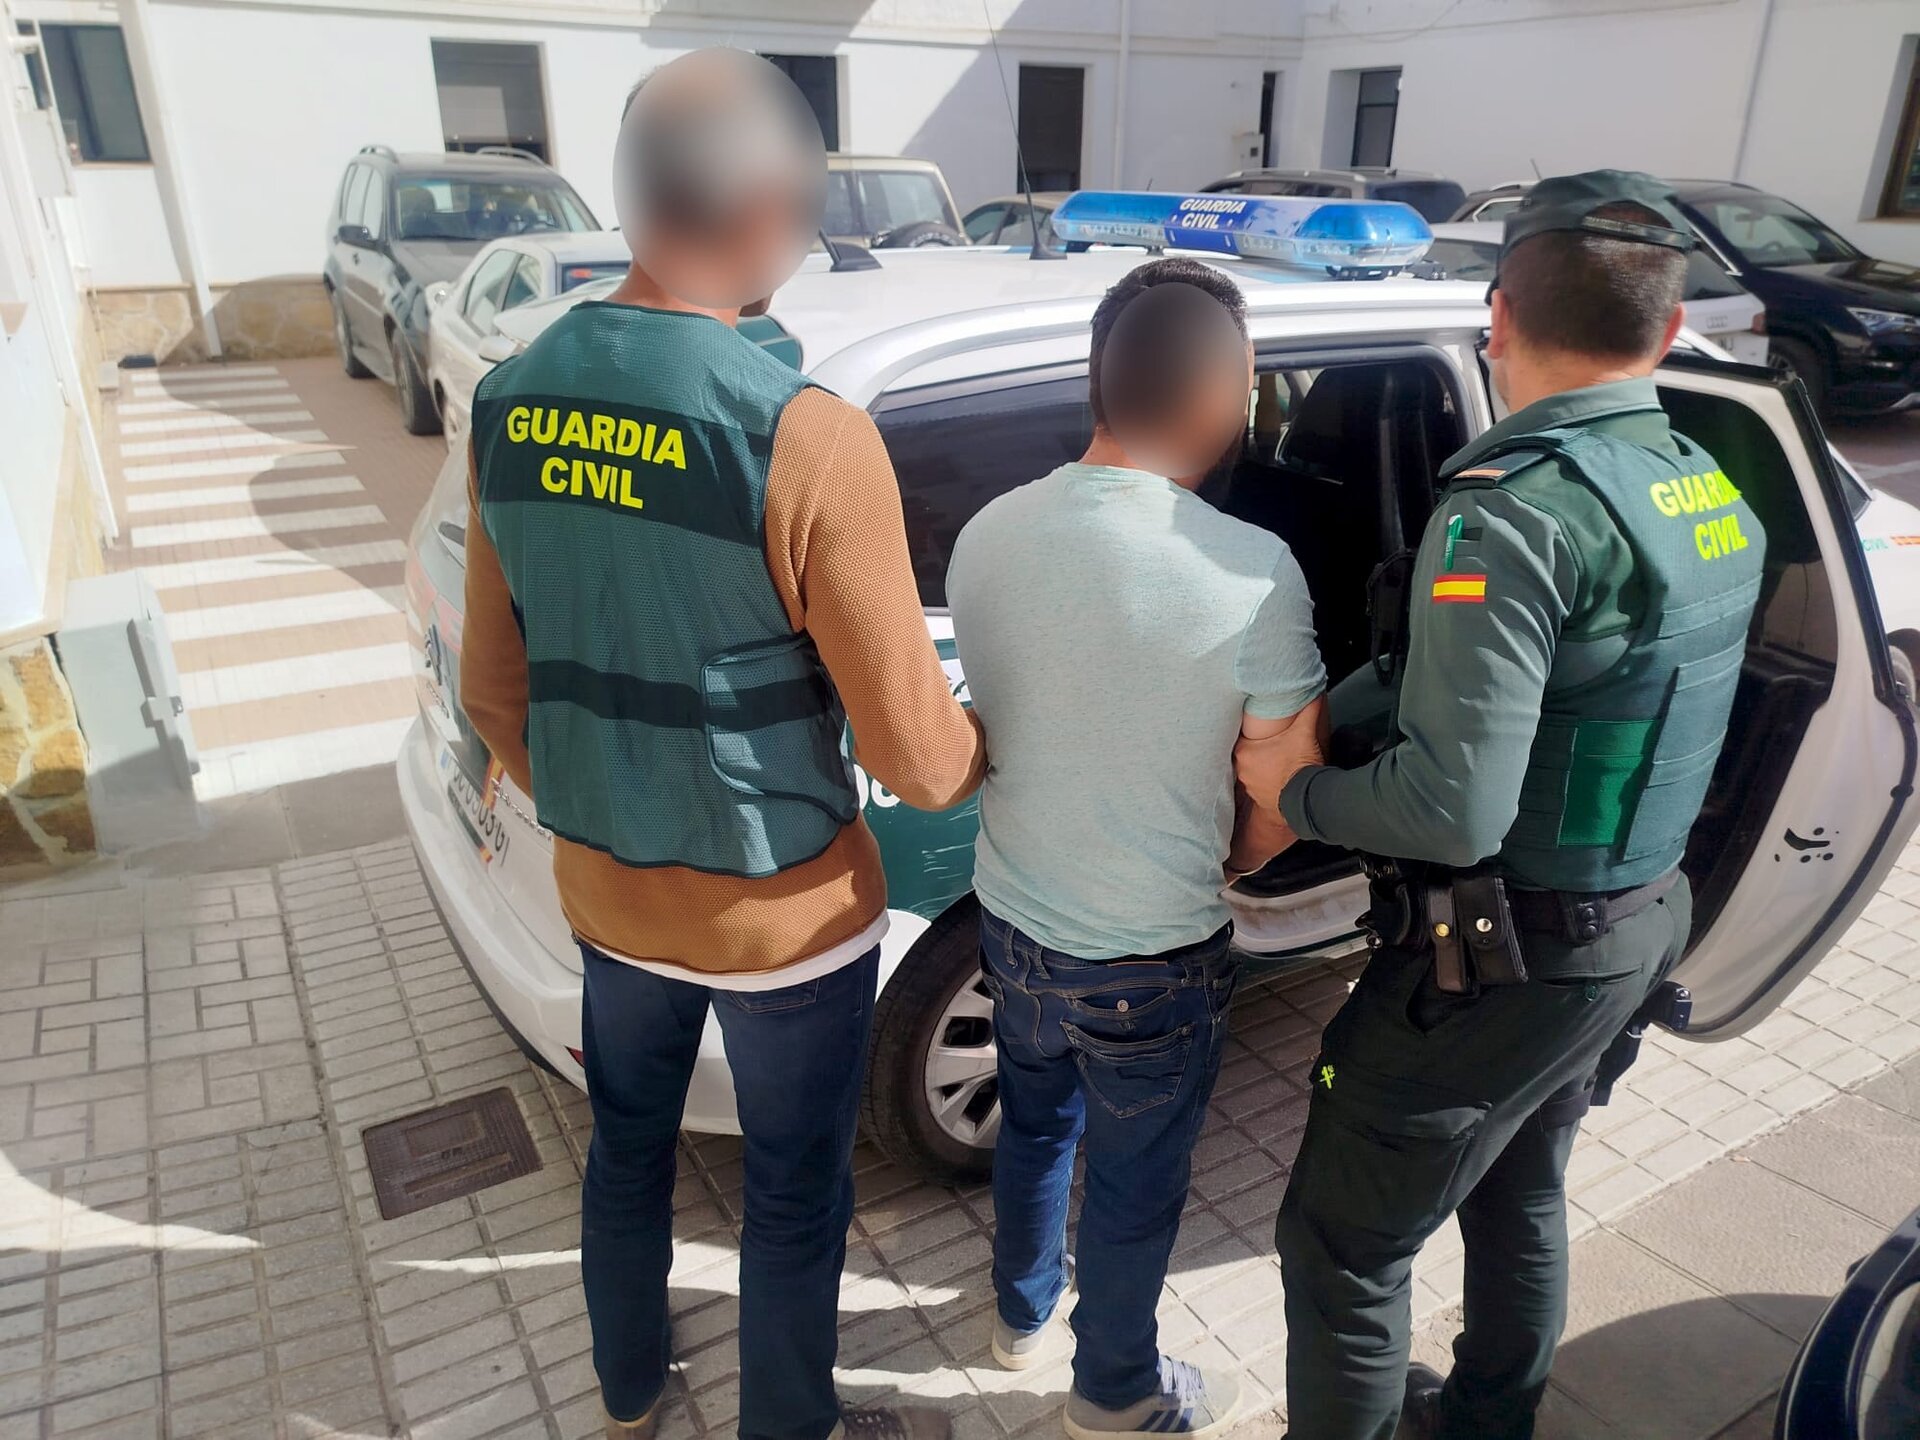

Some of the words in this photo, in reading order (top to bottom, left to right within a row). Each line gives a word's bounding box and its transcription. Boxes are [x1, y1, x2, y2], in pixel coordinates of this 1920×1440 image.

[1179, 198, 1247, 214] GUARDIA
[1181, 213, 1220, 230] CIVIL
[507, 406, 686, 470] GUARDIA
[541, 457, 643, 510] CIVIL
[1650, 469, 1742, 517] GUARD
[1695, 514, 1748, 560] CIVIL
